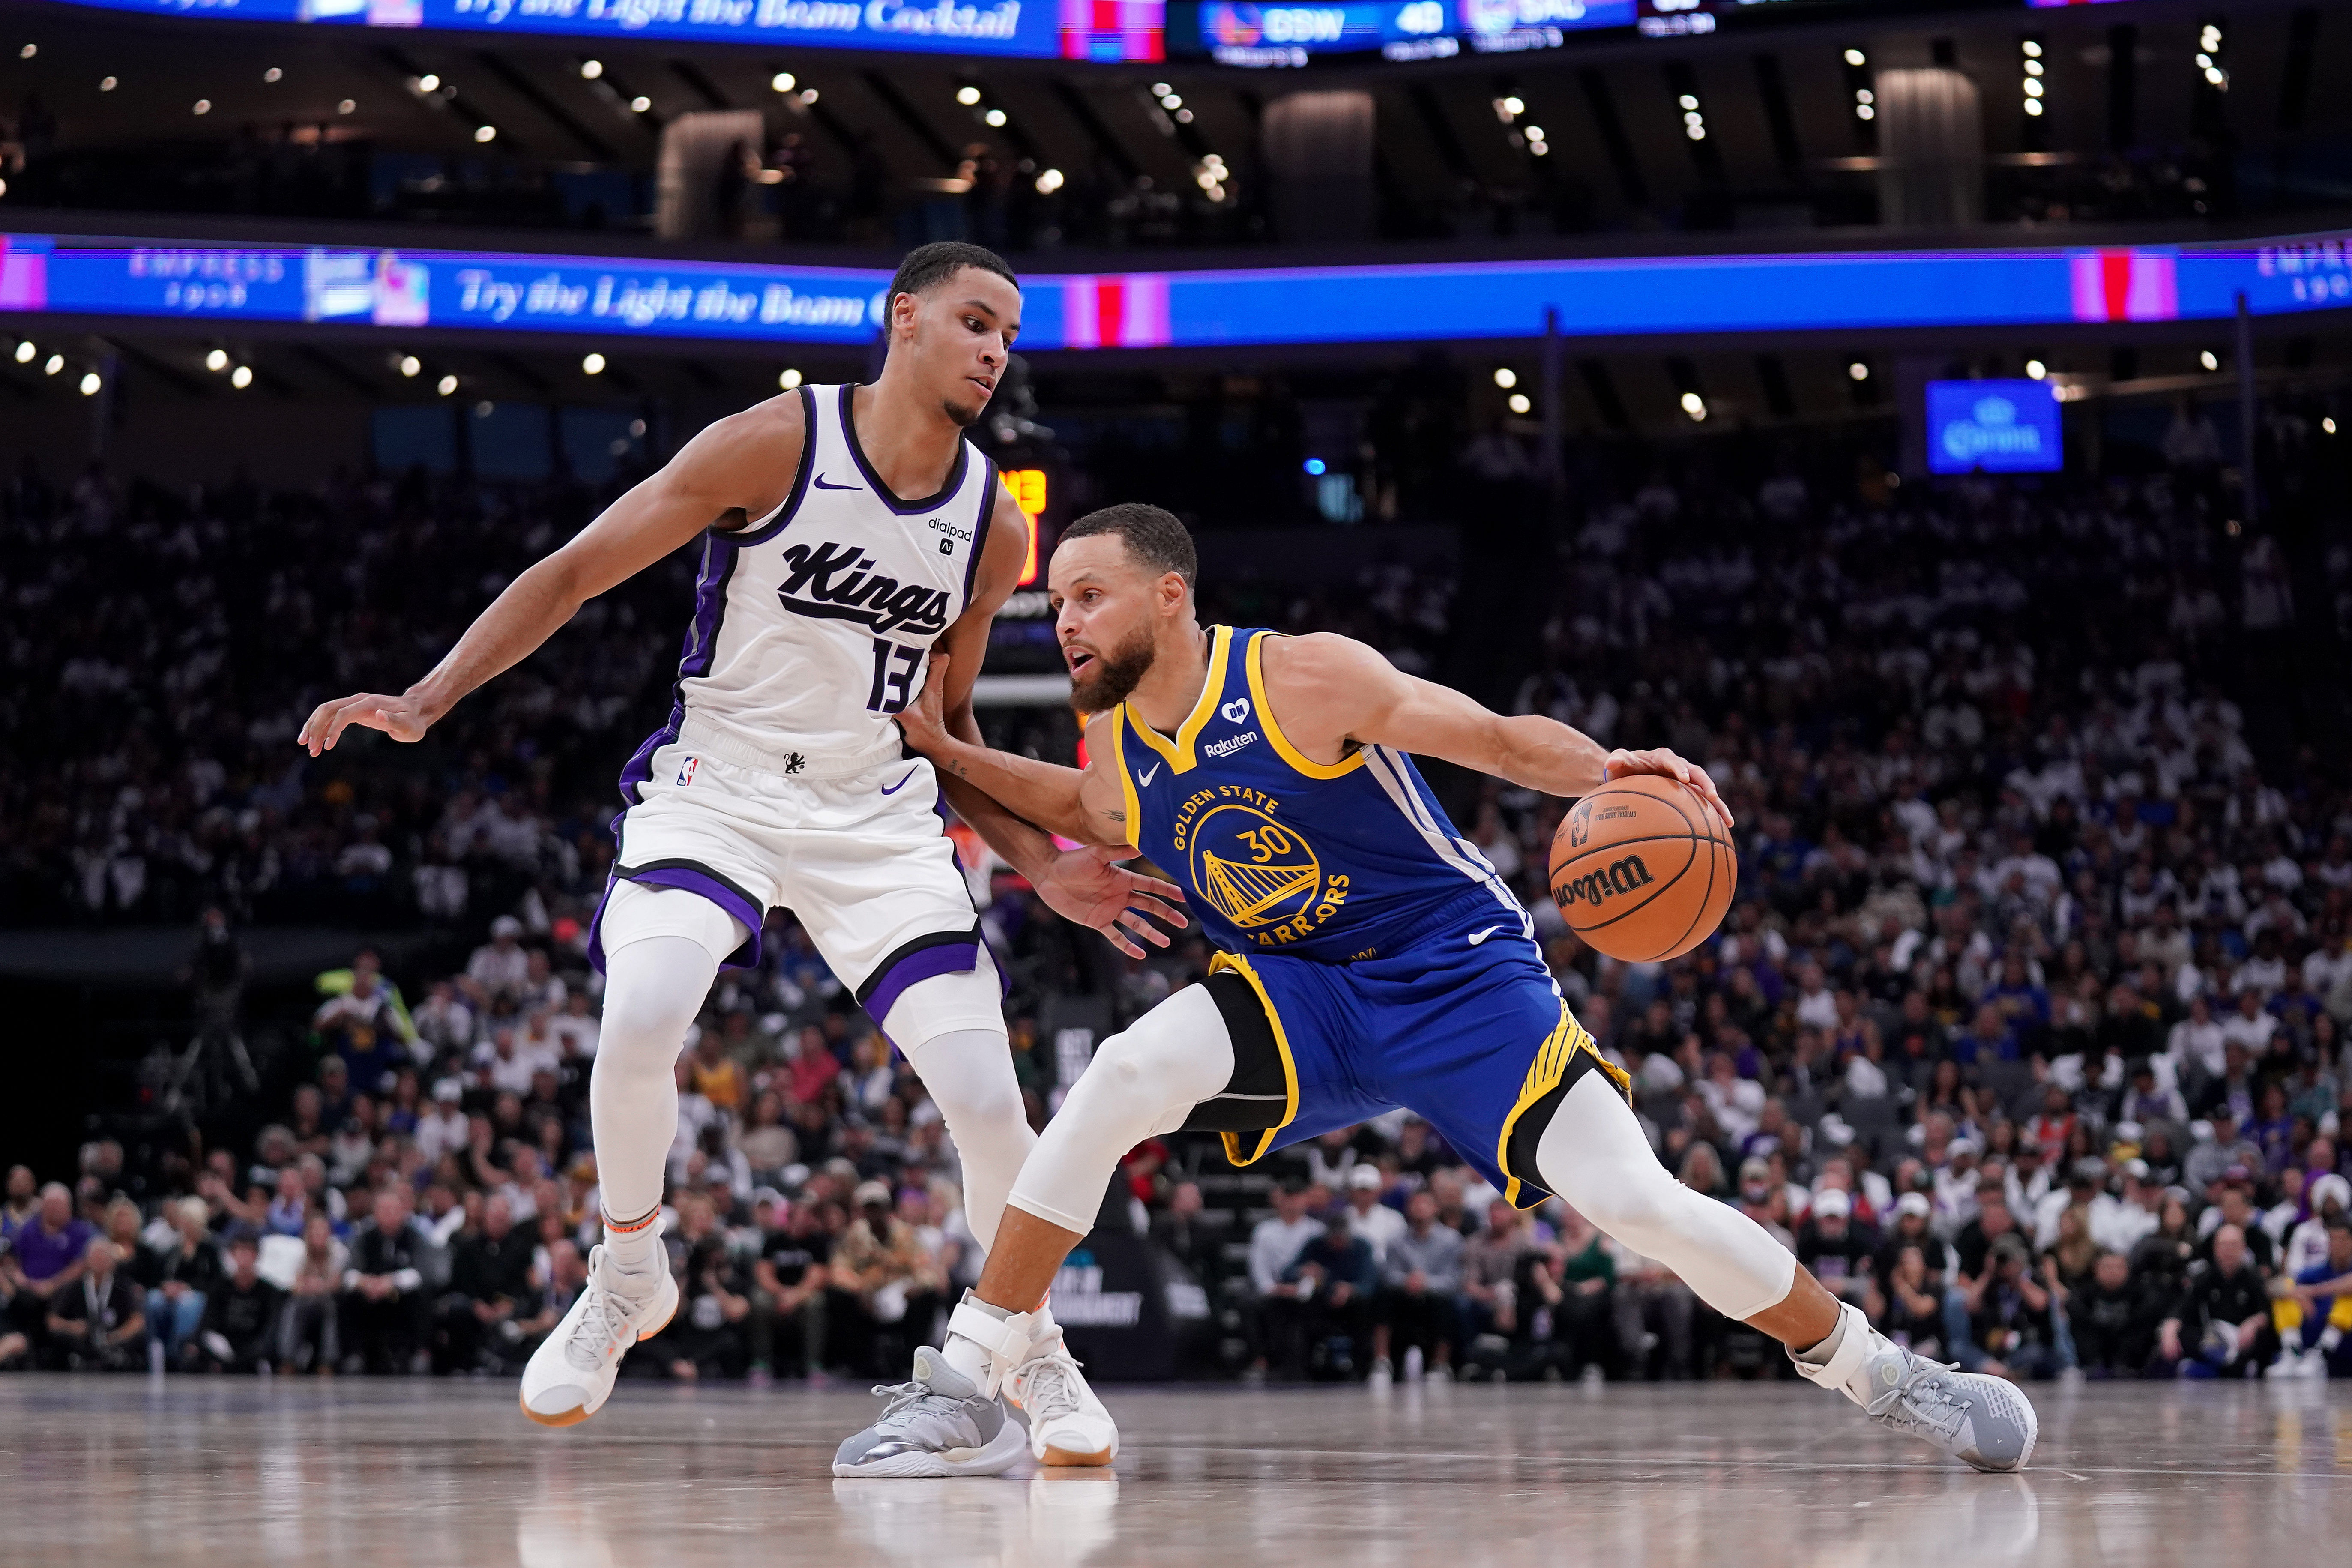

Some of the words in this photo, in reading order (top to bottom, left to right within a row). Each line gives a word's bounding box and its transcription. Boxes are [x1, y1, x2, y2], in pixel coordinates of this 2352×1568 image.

[1263, 8, 1346, 42] GSW
[455, 269, 524, 323] Try
[524, 272, 589, 315] the
[591, 274, 692, 328] Light
[693, 280, 758, 323] the
[758, 283, 865, 327] Beam
[928, 517, 973, 542] dialpad
[778, 542, 950, 635] Kings
[866, 638, 925, 714] 13
[1229, 704, 1245, 719] DM
[1204, 731, 1258, 758] Rakuten
[1174, 788, 1215, 851] GOLDEN
[1219, 785, 1279, 814] STATE
[1236, 825, 1291, 864] 30
[1553, 854, 1655, 909] Wilson
[1247, 874, 1350, 946] ARRORS
